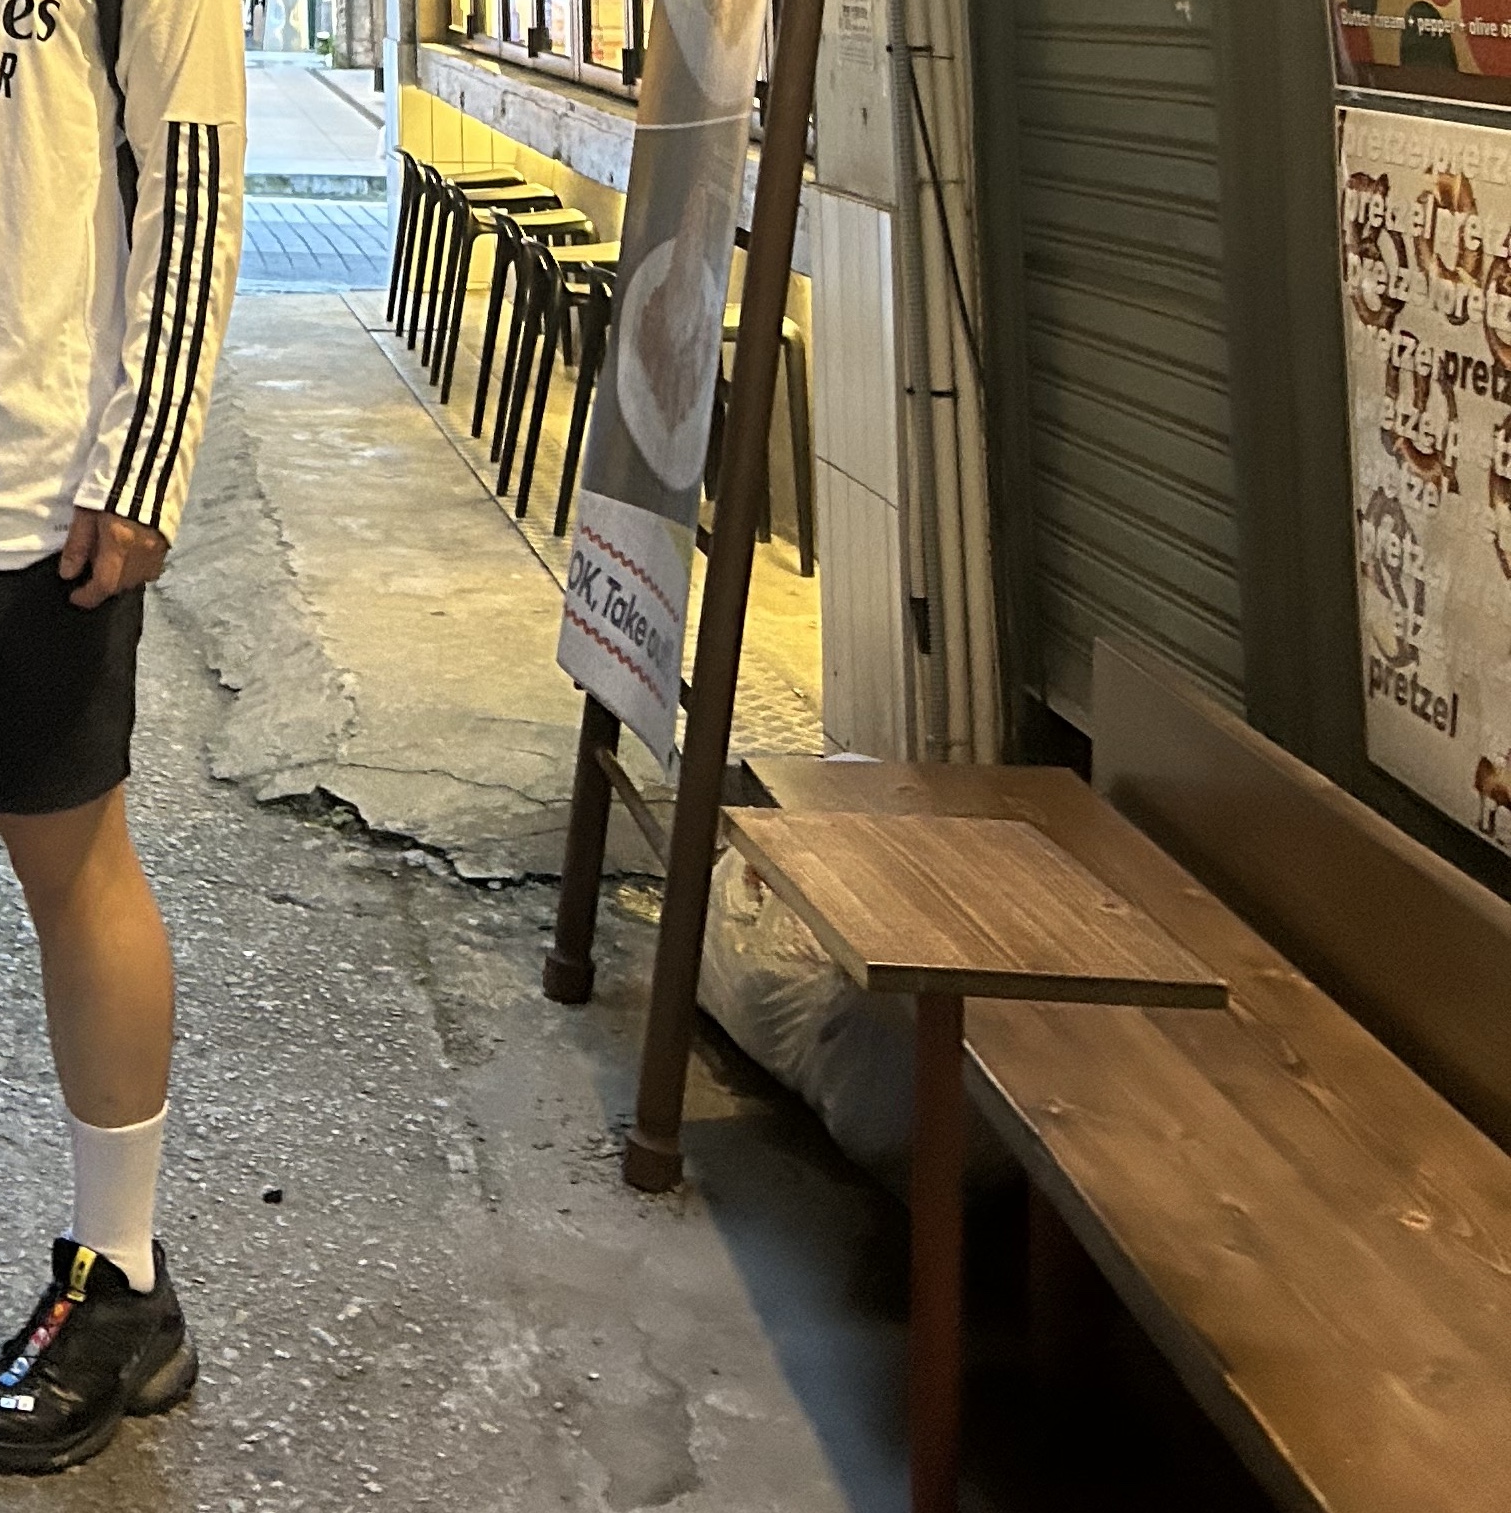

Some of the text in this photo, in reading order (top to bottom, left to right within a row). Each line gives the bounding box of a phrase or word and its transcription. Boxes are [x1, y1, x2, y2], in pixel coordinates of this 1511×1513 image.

[1469, 17, 1499, 37] olive
[568, 549, 602, 613] OK,
[601, 575, 648, 647] Take
[1369, 654, 1459, 739] pretzel
